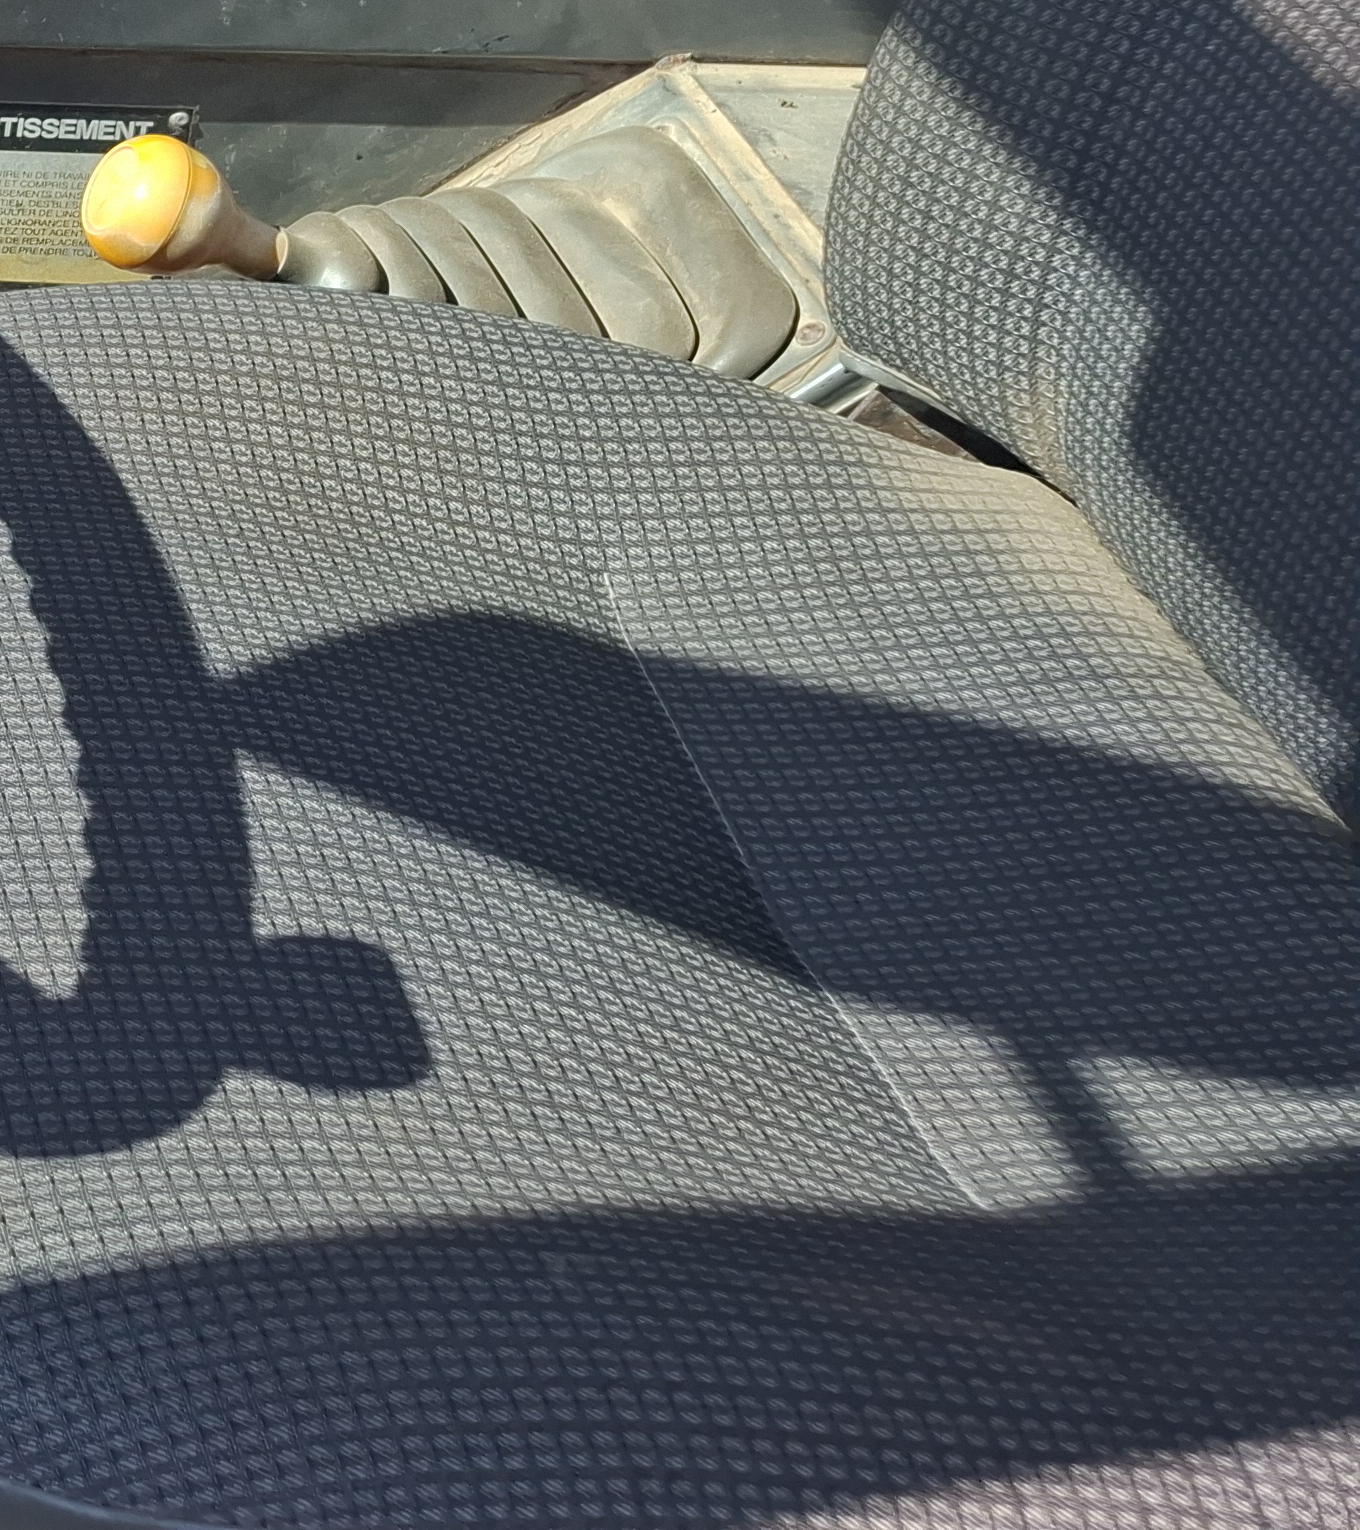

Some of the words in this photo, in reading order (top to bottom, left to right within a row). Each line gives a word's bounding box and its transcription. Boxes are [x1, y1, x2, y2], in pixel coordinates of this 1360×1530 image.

[22, 170, 33, 179] NI
[35, 171, 48, 180] DE
[4, 179, 19, 188] ET
[20, 180, 69, 190] COMPRIS
[28, 199, 49, 209] DES
[51, 200, 81, 210] BLES
[38, 208, 54, 218] DE
[20, 227, 46, 237] TOUT
[5, 236, 20, 245] DE
[1, 246, 17, 255] DE
[19, 246, 68, 256] PRENDRE
